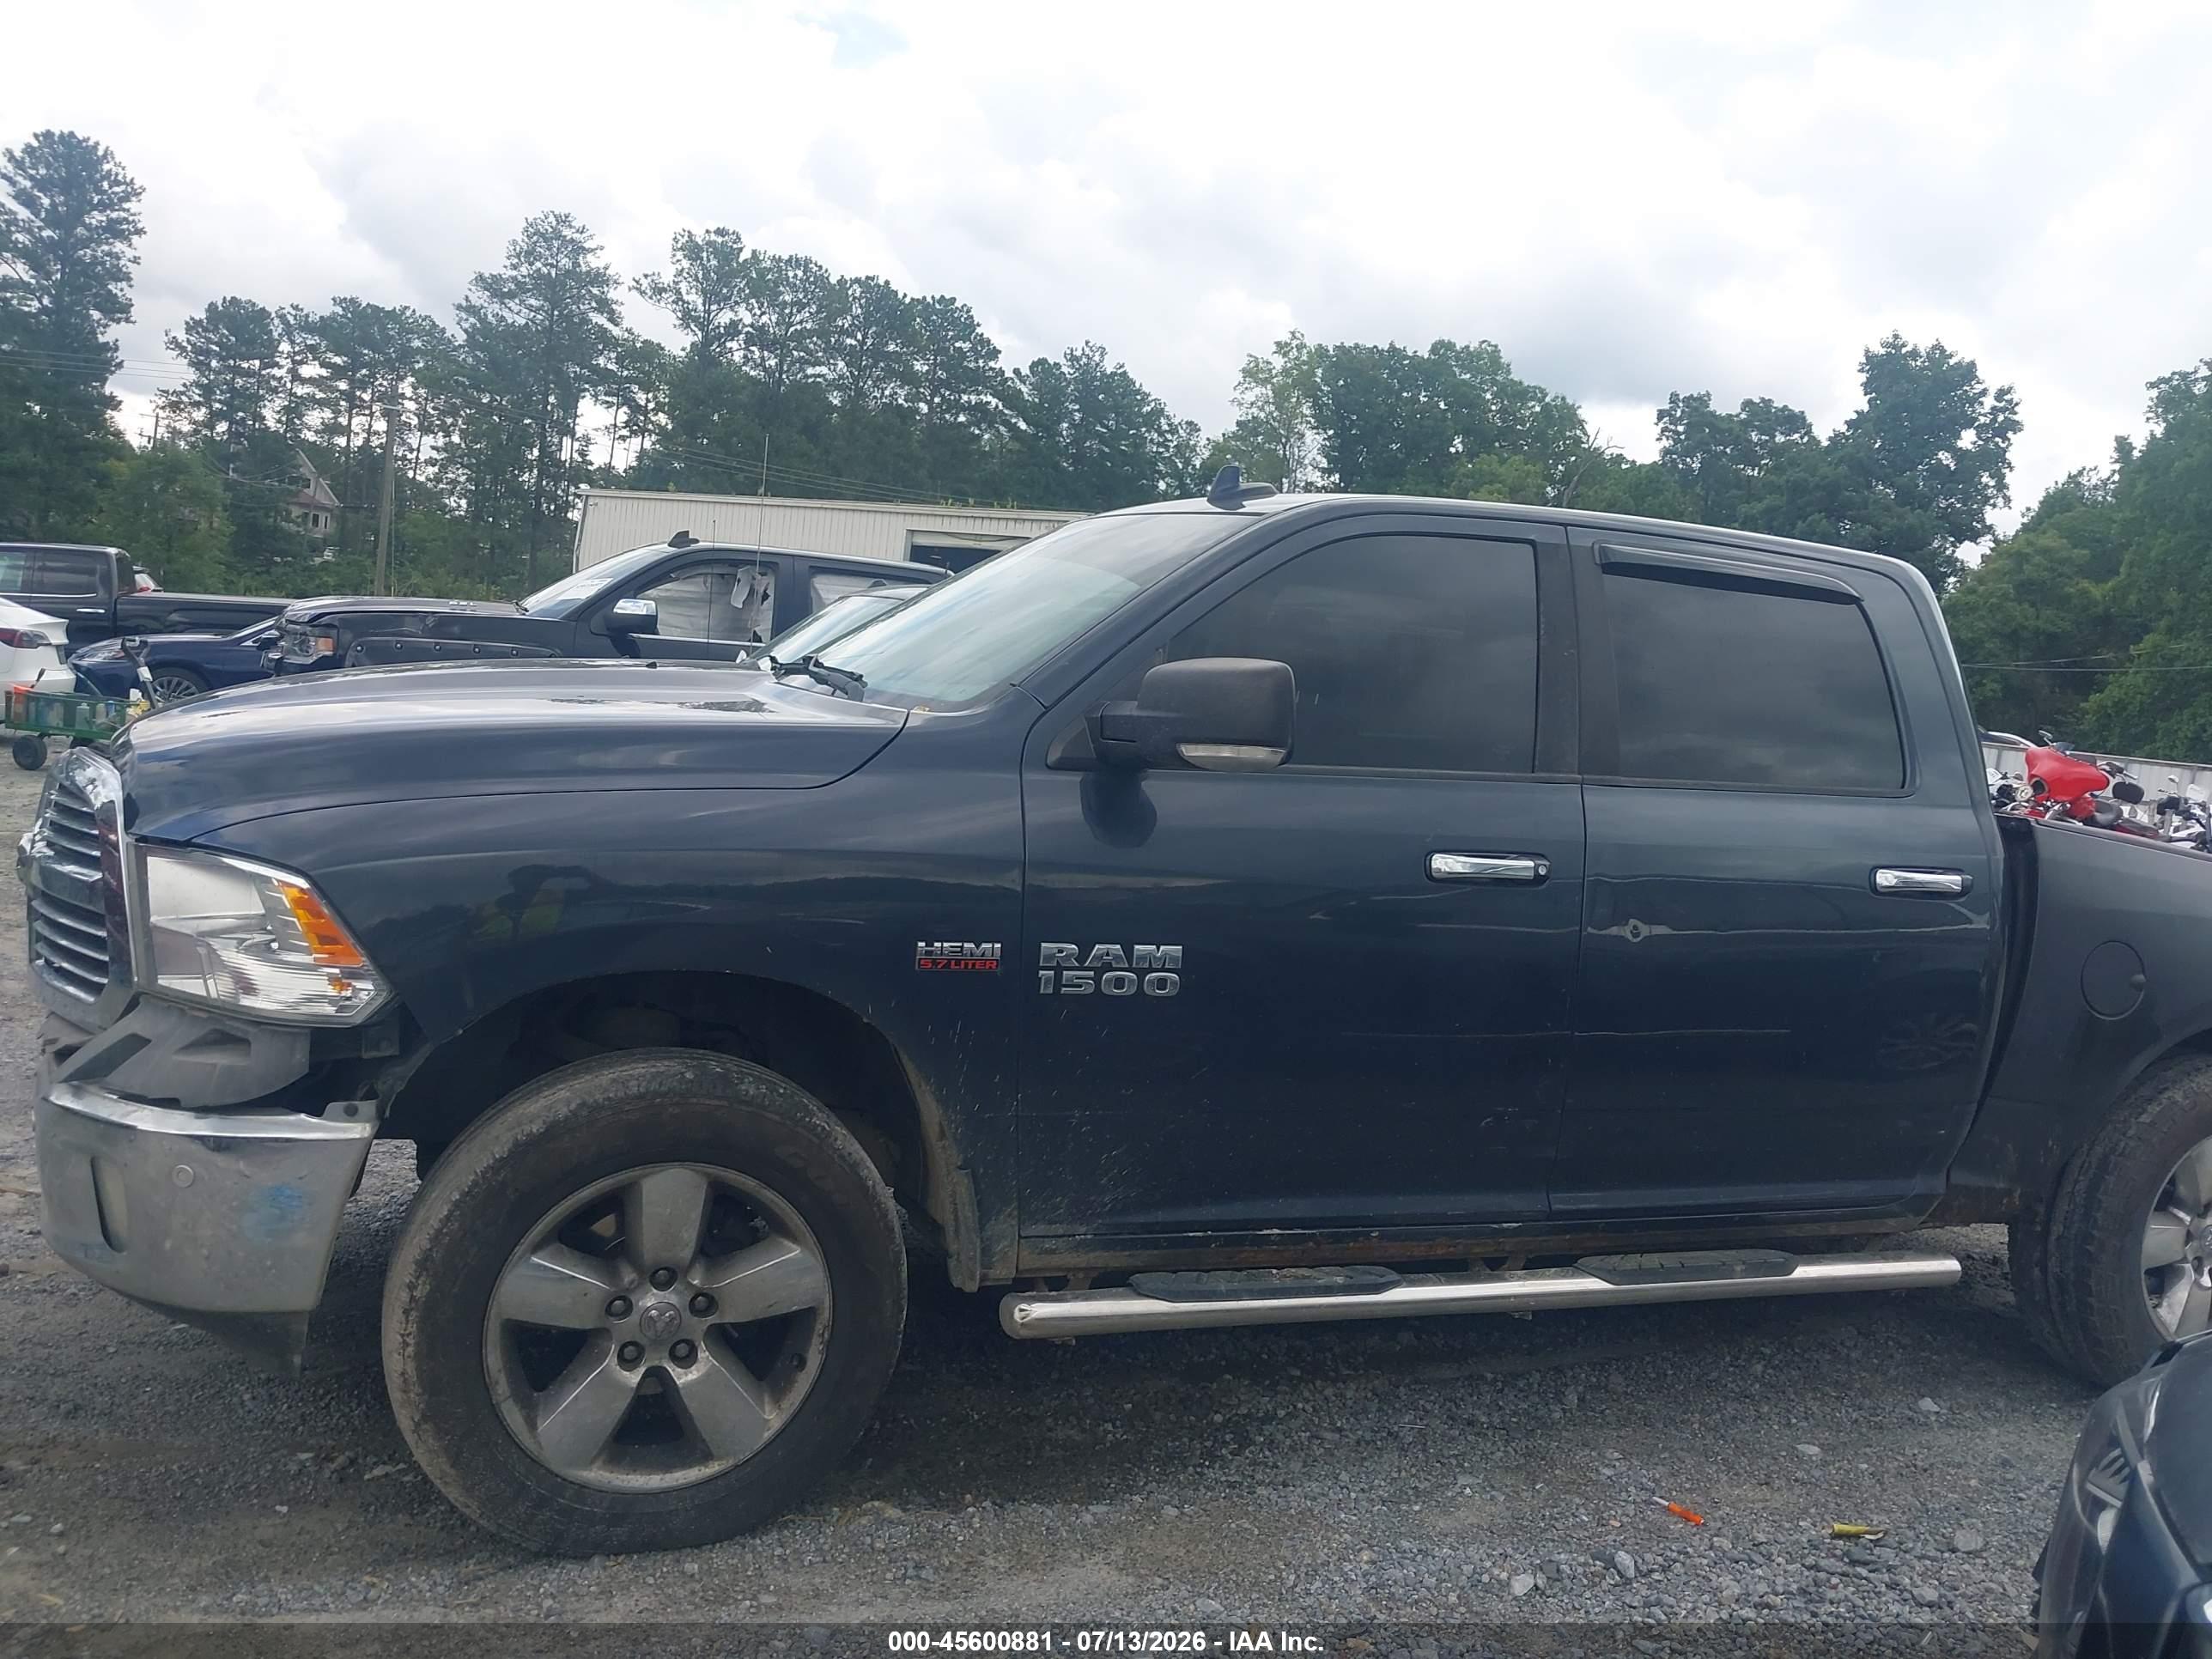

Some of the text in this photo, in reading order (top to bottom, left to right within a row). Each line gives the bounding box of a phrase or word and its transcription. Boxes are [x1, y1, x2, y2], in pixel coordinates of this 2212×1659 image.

[916, 941, 1001, 957] HEMI
[1039, 942, 1182, 969] RAM
[950, 960, 998, 969] LITER
[1038, 970, 1181, 996] 1500
